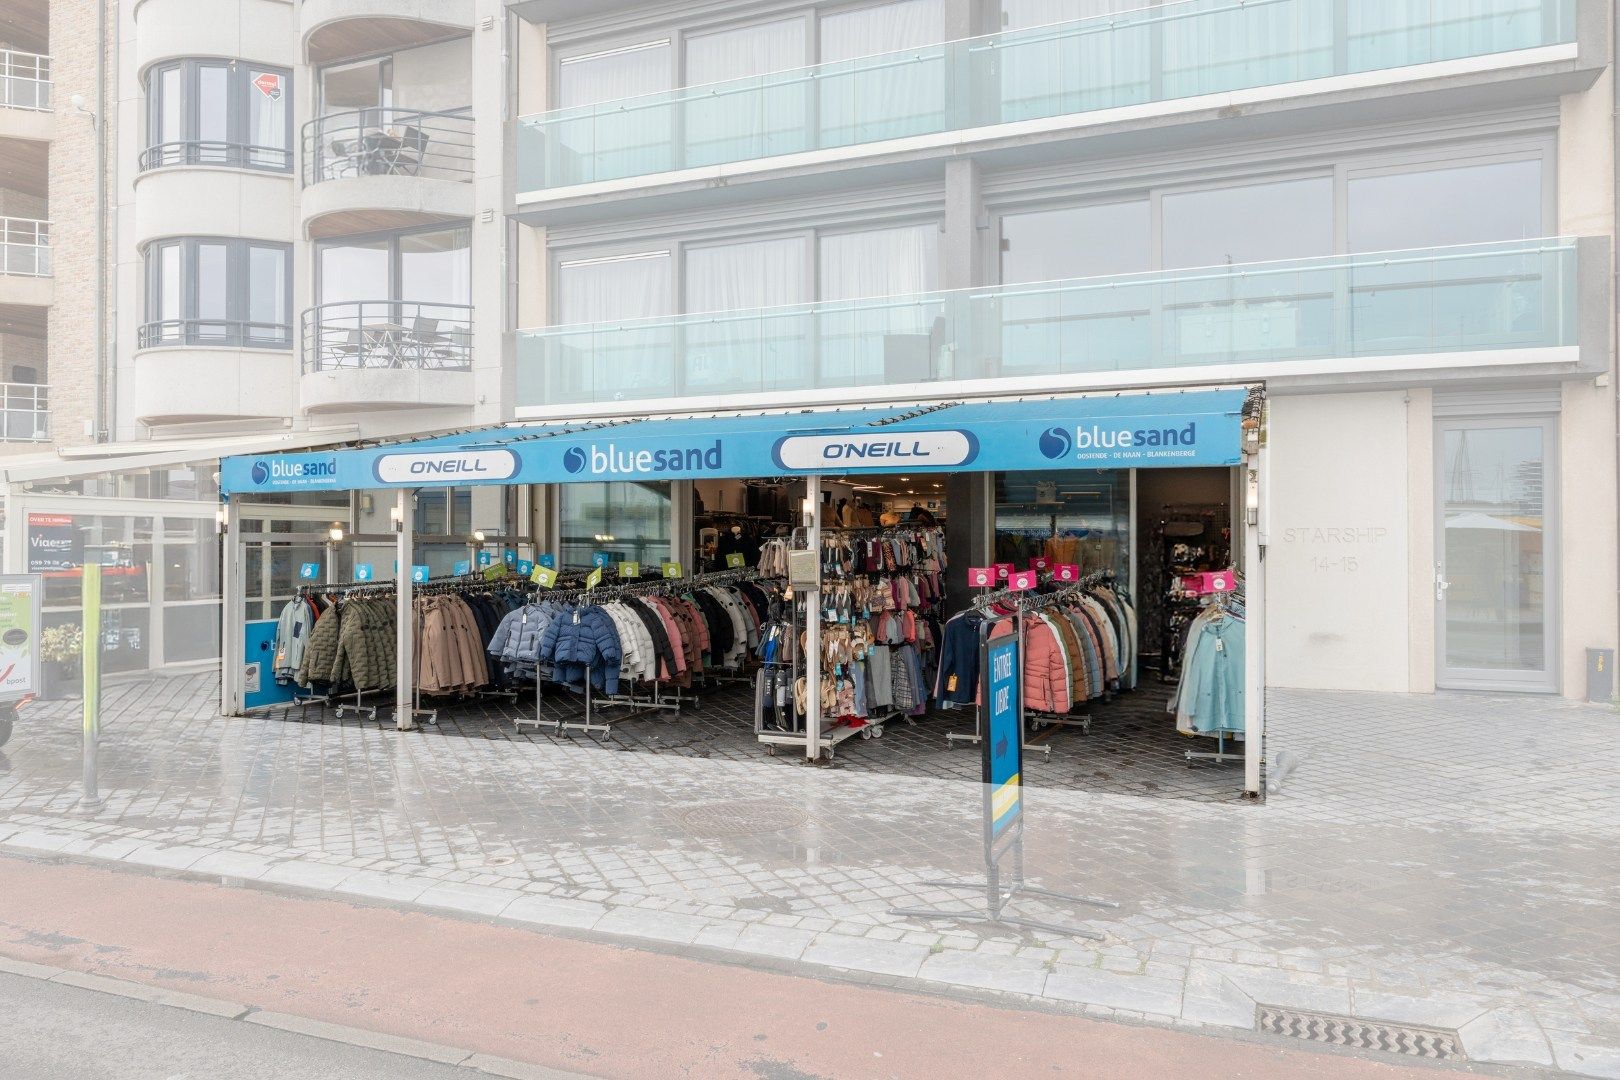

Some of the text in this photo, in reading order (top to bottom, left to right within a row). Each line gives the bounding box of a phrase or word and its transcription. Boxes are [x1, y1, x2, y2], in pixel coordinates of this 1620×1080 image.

[1076, 422, 1196, 449] bluesand
[591, 439, 722, 475] bluesand
[823, 441, 930, 459] O'NEILL
[1147, 450, 1196, 458] BLANKENBERGE
[272, 457, 337, 477] bluesand
[410, 458, 487, 474] O'NEILL
[1282, 527, 1388, 544] STARSHIP
[6, 677, 26, 685] bpost
